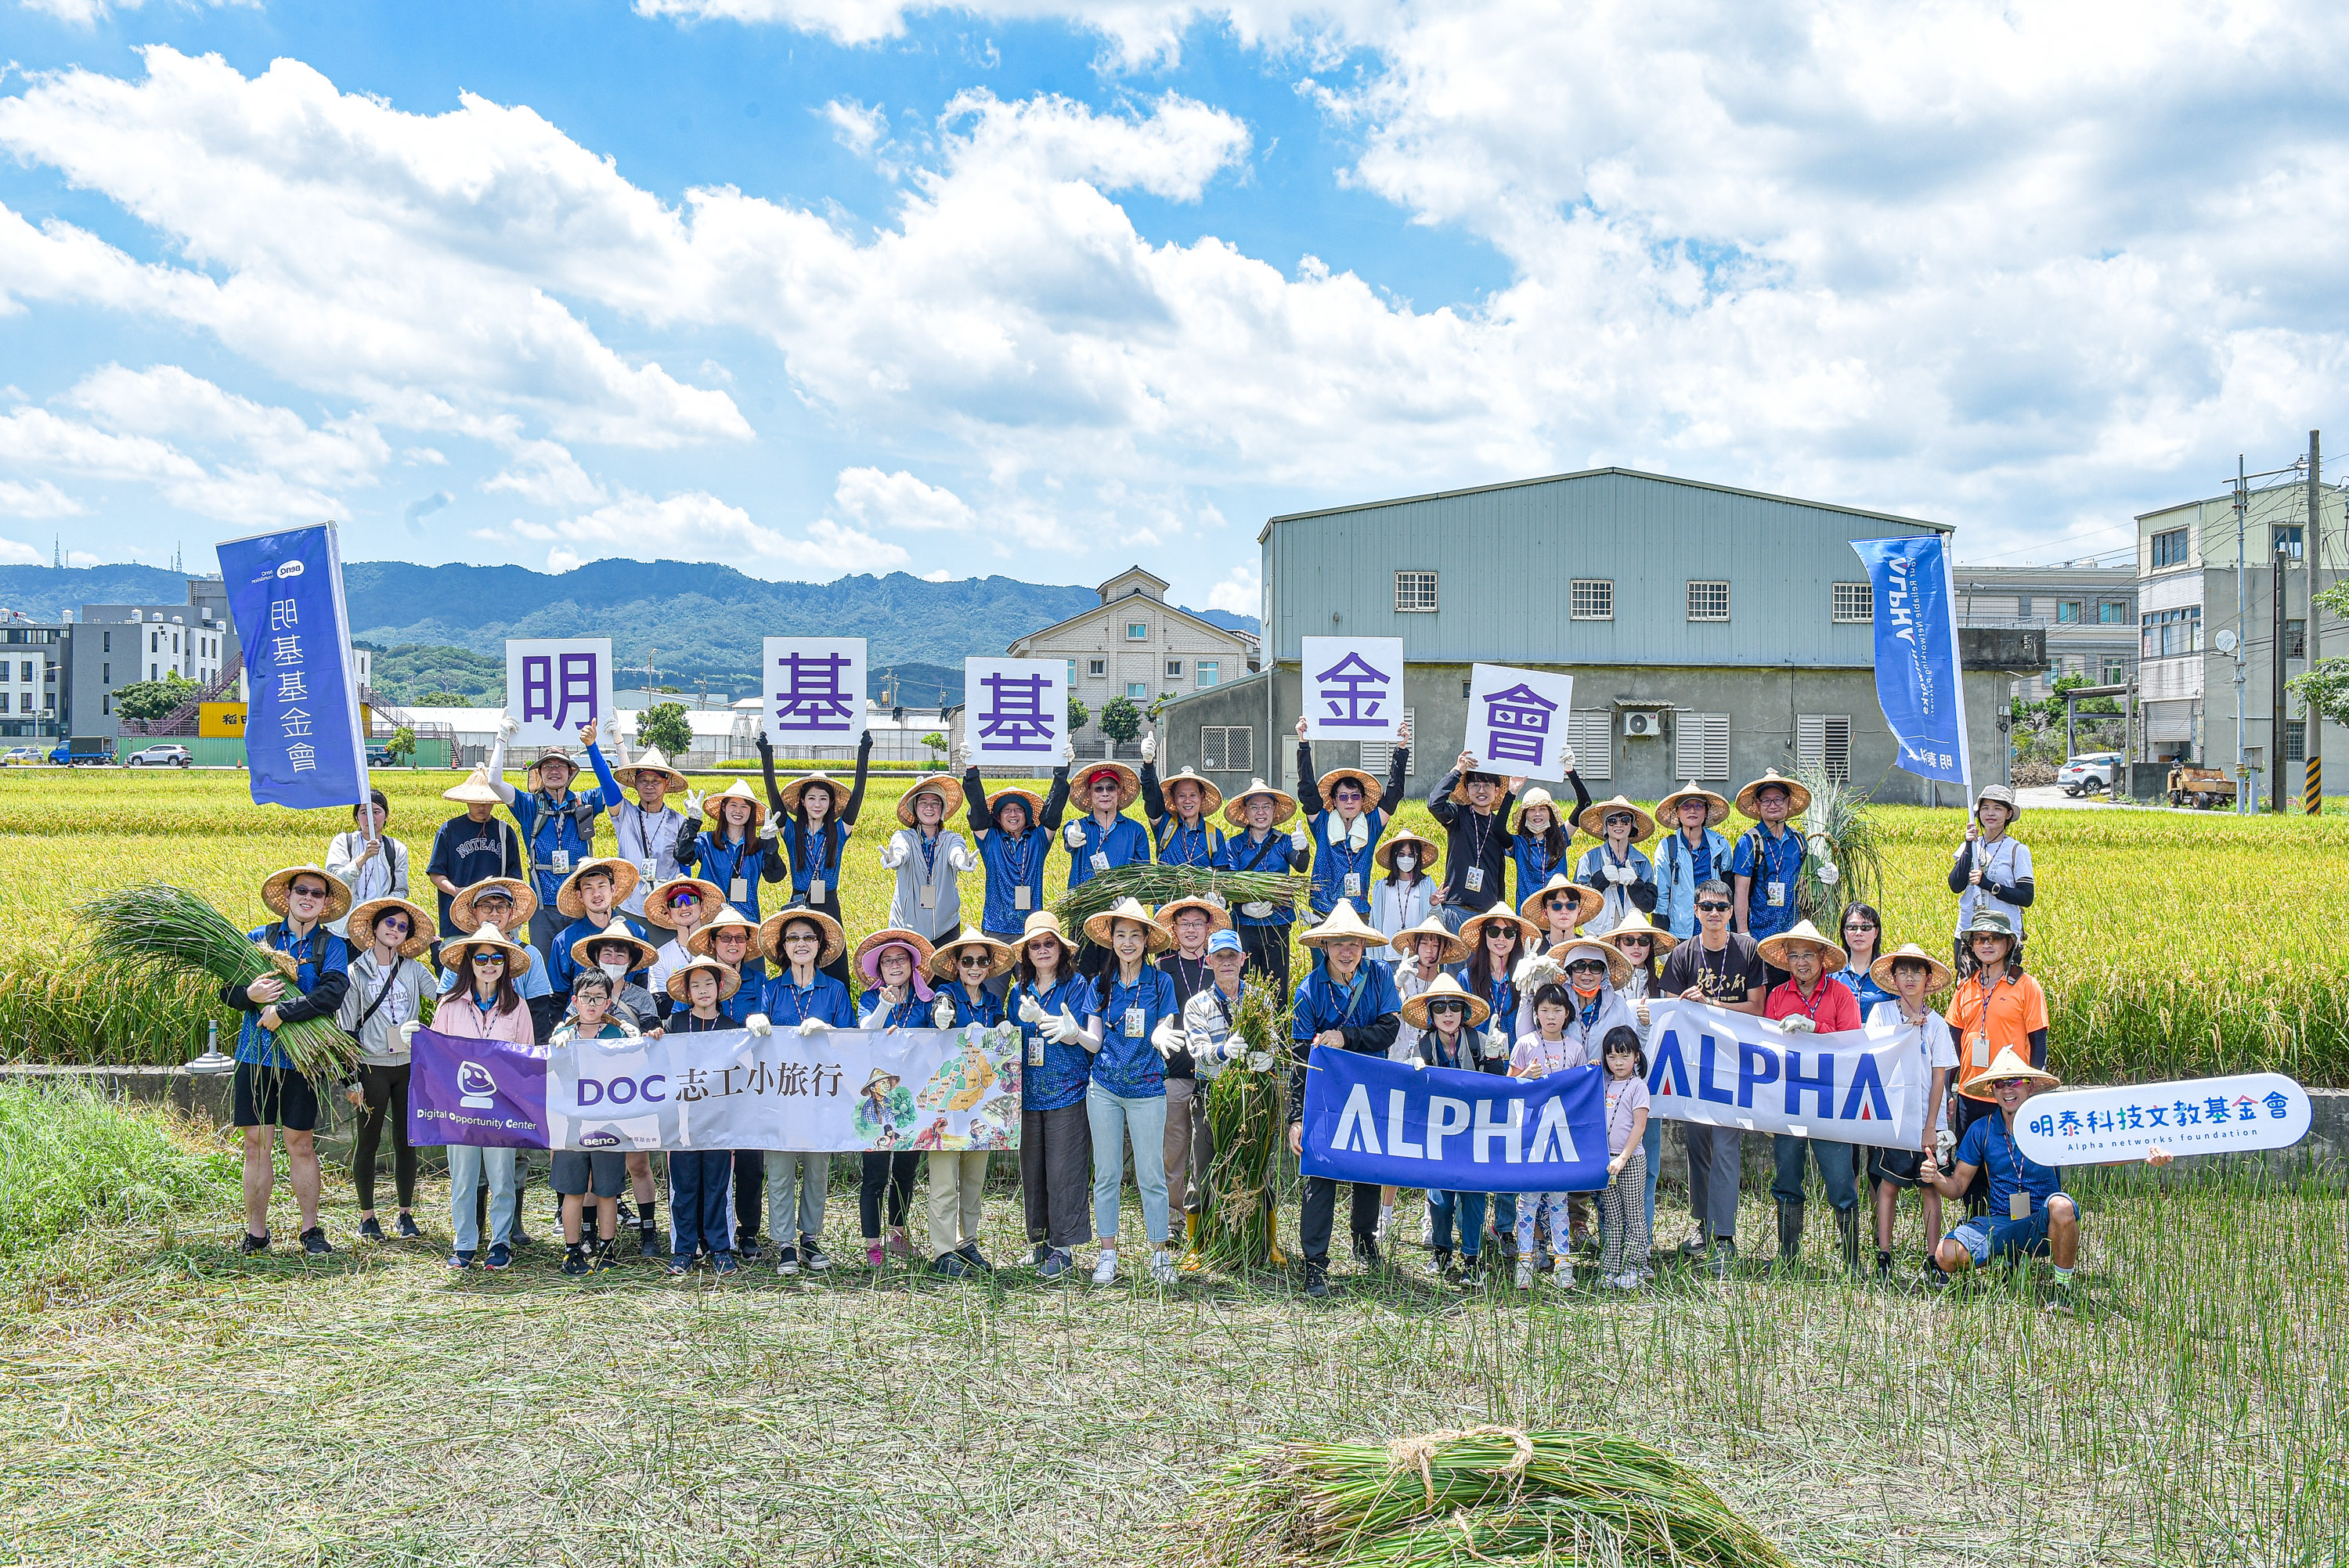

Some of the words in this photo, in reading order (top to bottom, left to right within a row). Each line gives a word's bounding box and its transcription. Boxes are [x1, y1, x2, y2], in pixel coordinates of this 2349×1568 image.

[522, 653, 597, 731] 明
[776, 652, 854, 731] 基
[977, 672, 1055, 752] 基
[1315, 651, 1391, 727] 金
[1482, 683, 1558, 766] 會
[577, 1074, 666, 1106] DOC
[676, 1061, 843, 1101] 志工小旅行
[1647, 1029, 1893, 1120] ALPHA
[417, 1108, 447, 1120] Digital
[449, 1112, 504, 1130] Opportunity
[505, 1119, 536, 1130] Center
[583, 1137, 617, 1146] BenQ
[1330, 1083, 1580, 1163] ALPHA
[2030, 1090, 2289, 1138] 明泰科技文教基金會
[2067, 1140, 2104, 1152] Alpha
[2112, 1135, 2173, 1148] networks
[2181, 1127, 2258, 1141] foundation
